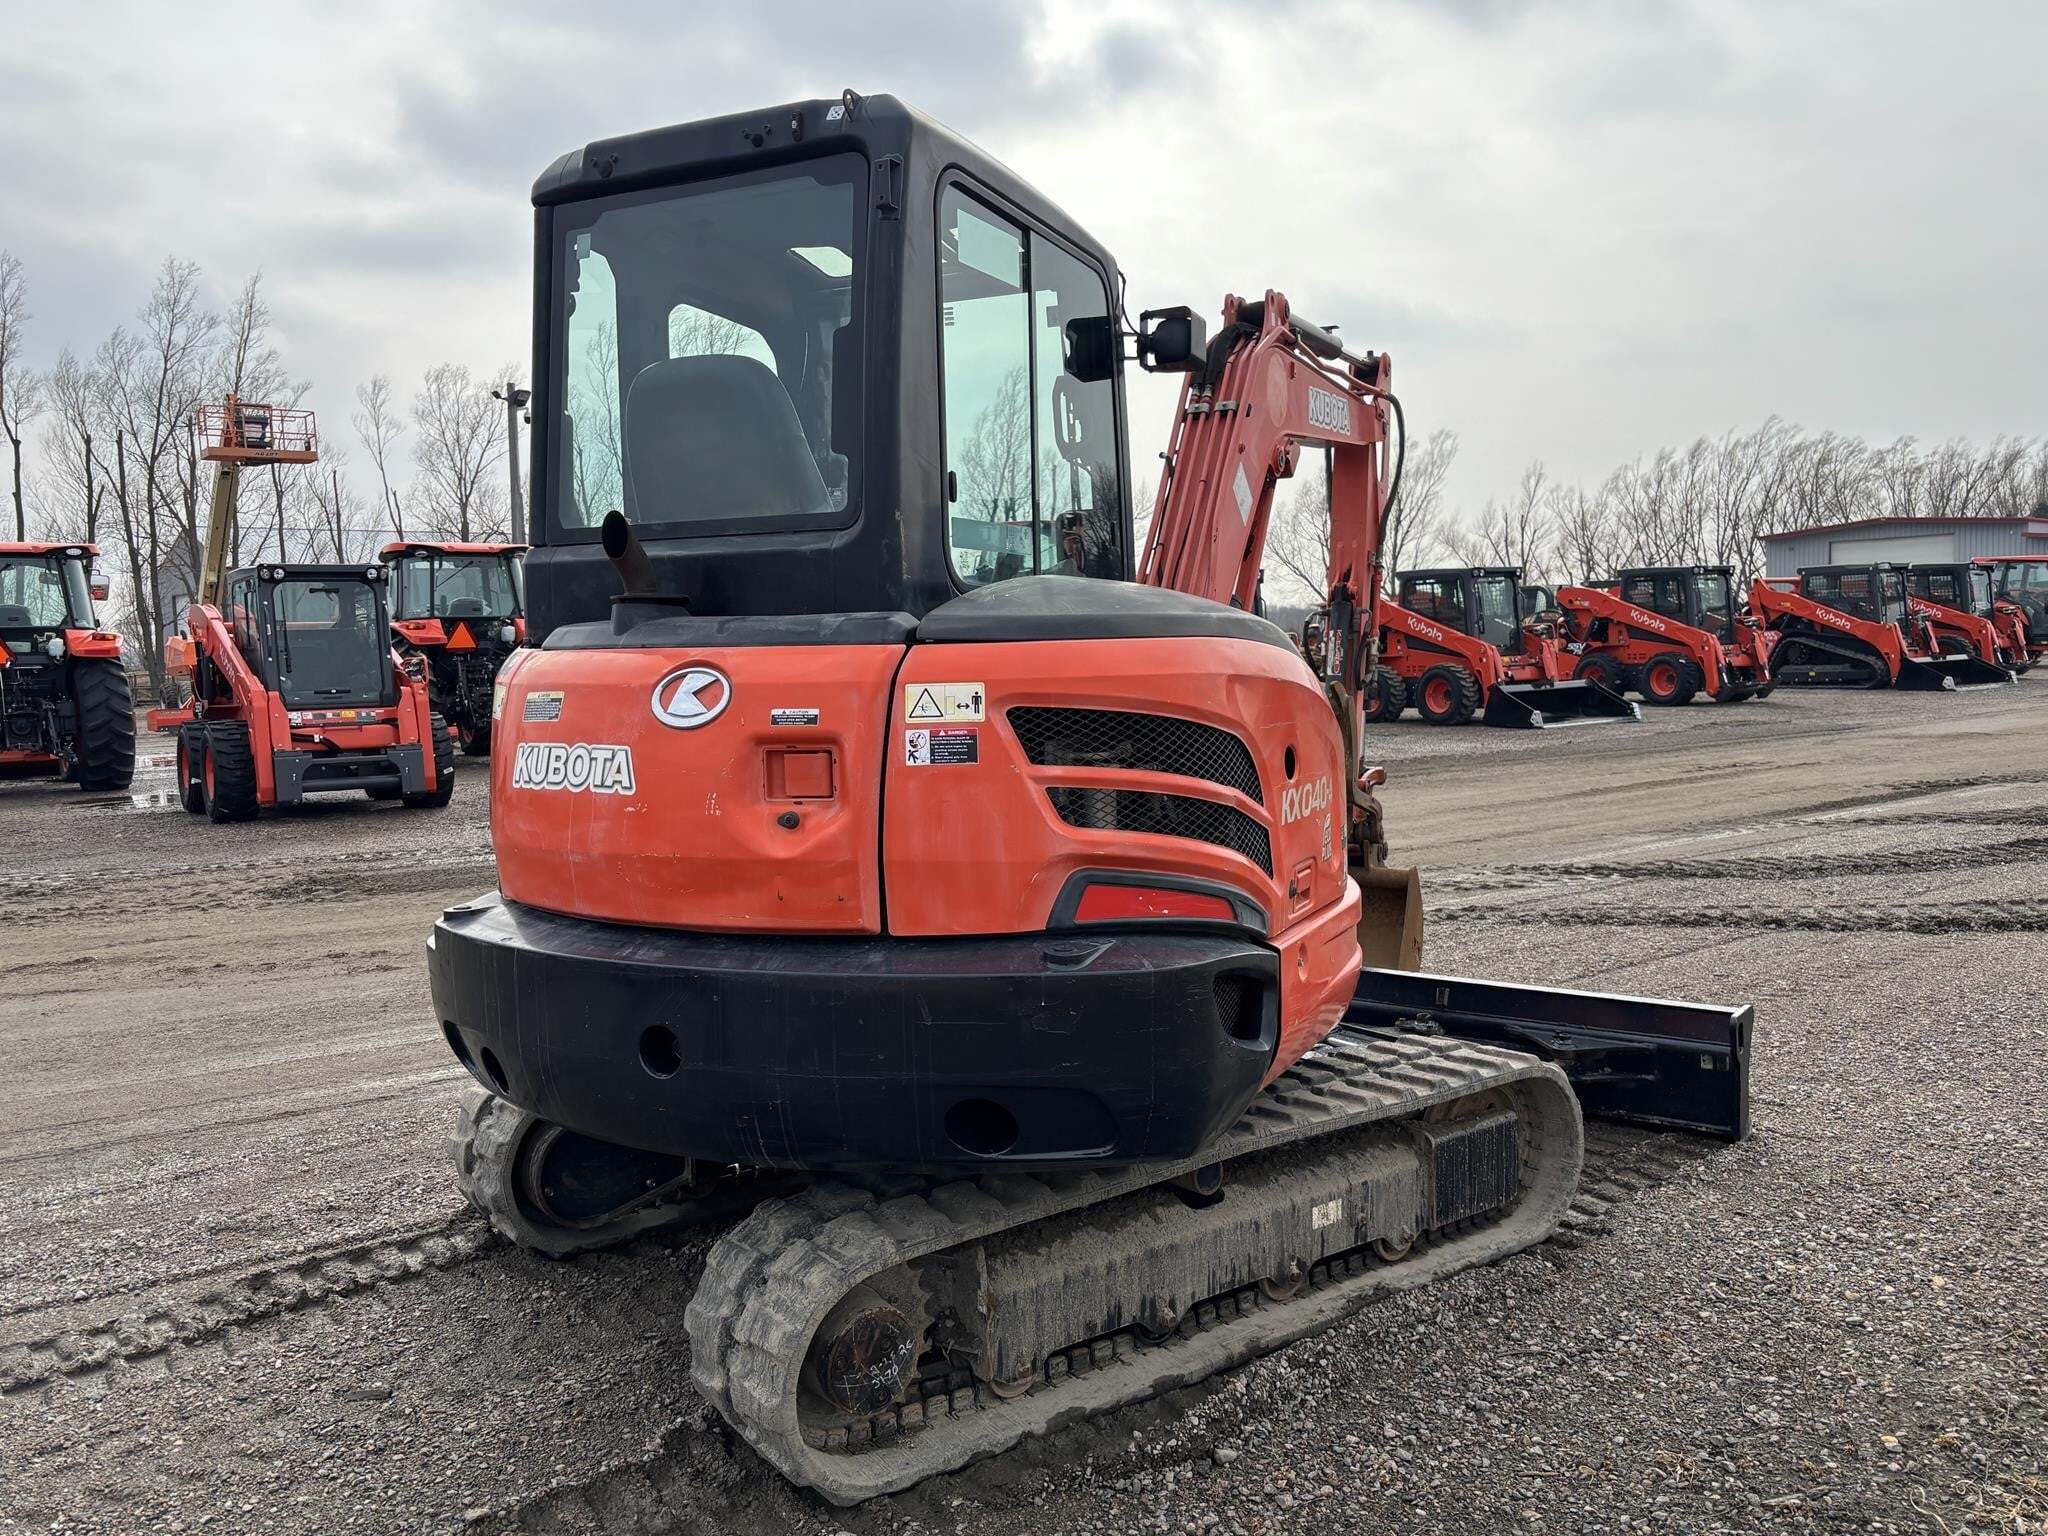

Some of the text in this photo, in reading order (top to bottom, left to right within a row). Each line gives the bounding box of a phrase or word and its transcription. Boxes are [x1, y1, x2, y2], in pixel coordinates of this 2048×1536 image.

[1308, 386, 1351, 436] KUBOTA
[1407, 616, 1442, 641] Kubota
[1630, 609, 1666, 632] Kubota
[1815, 607, 1851, 630] Kubota
[514, 745, 634, 791] KUBOTA
